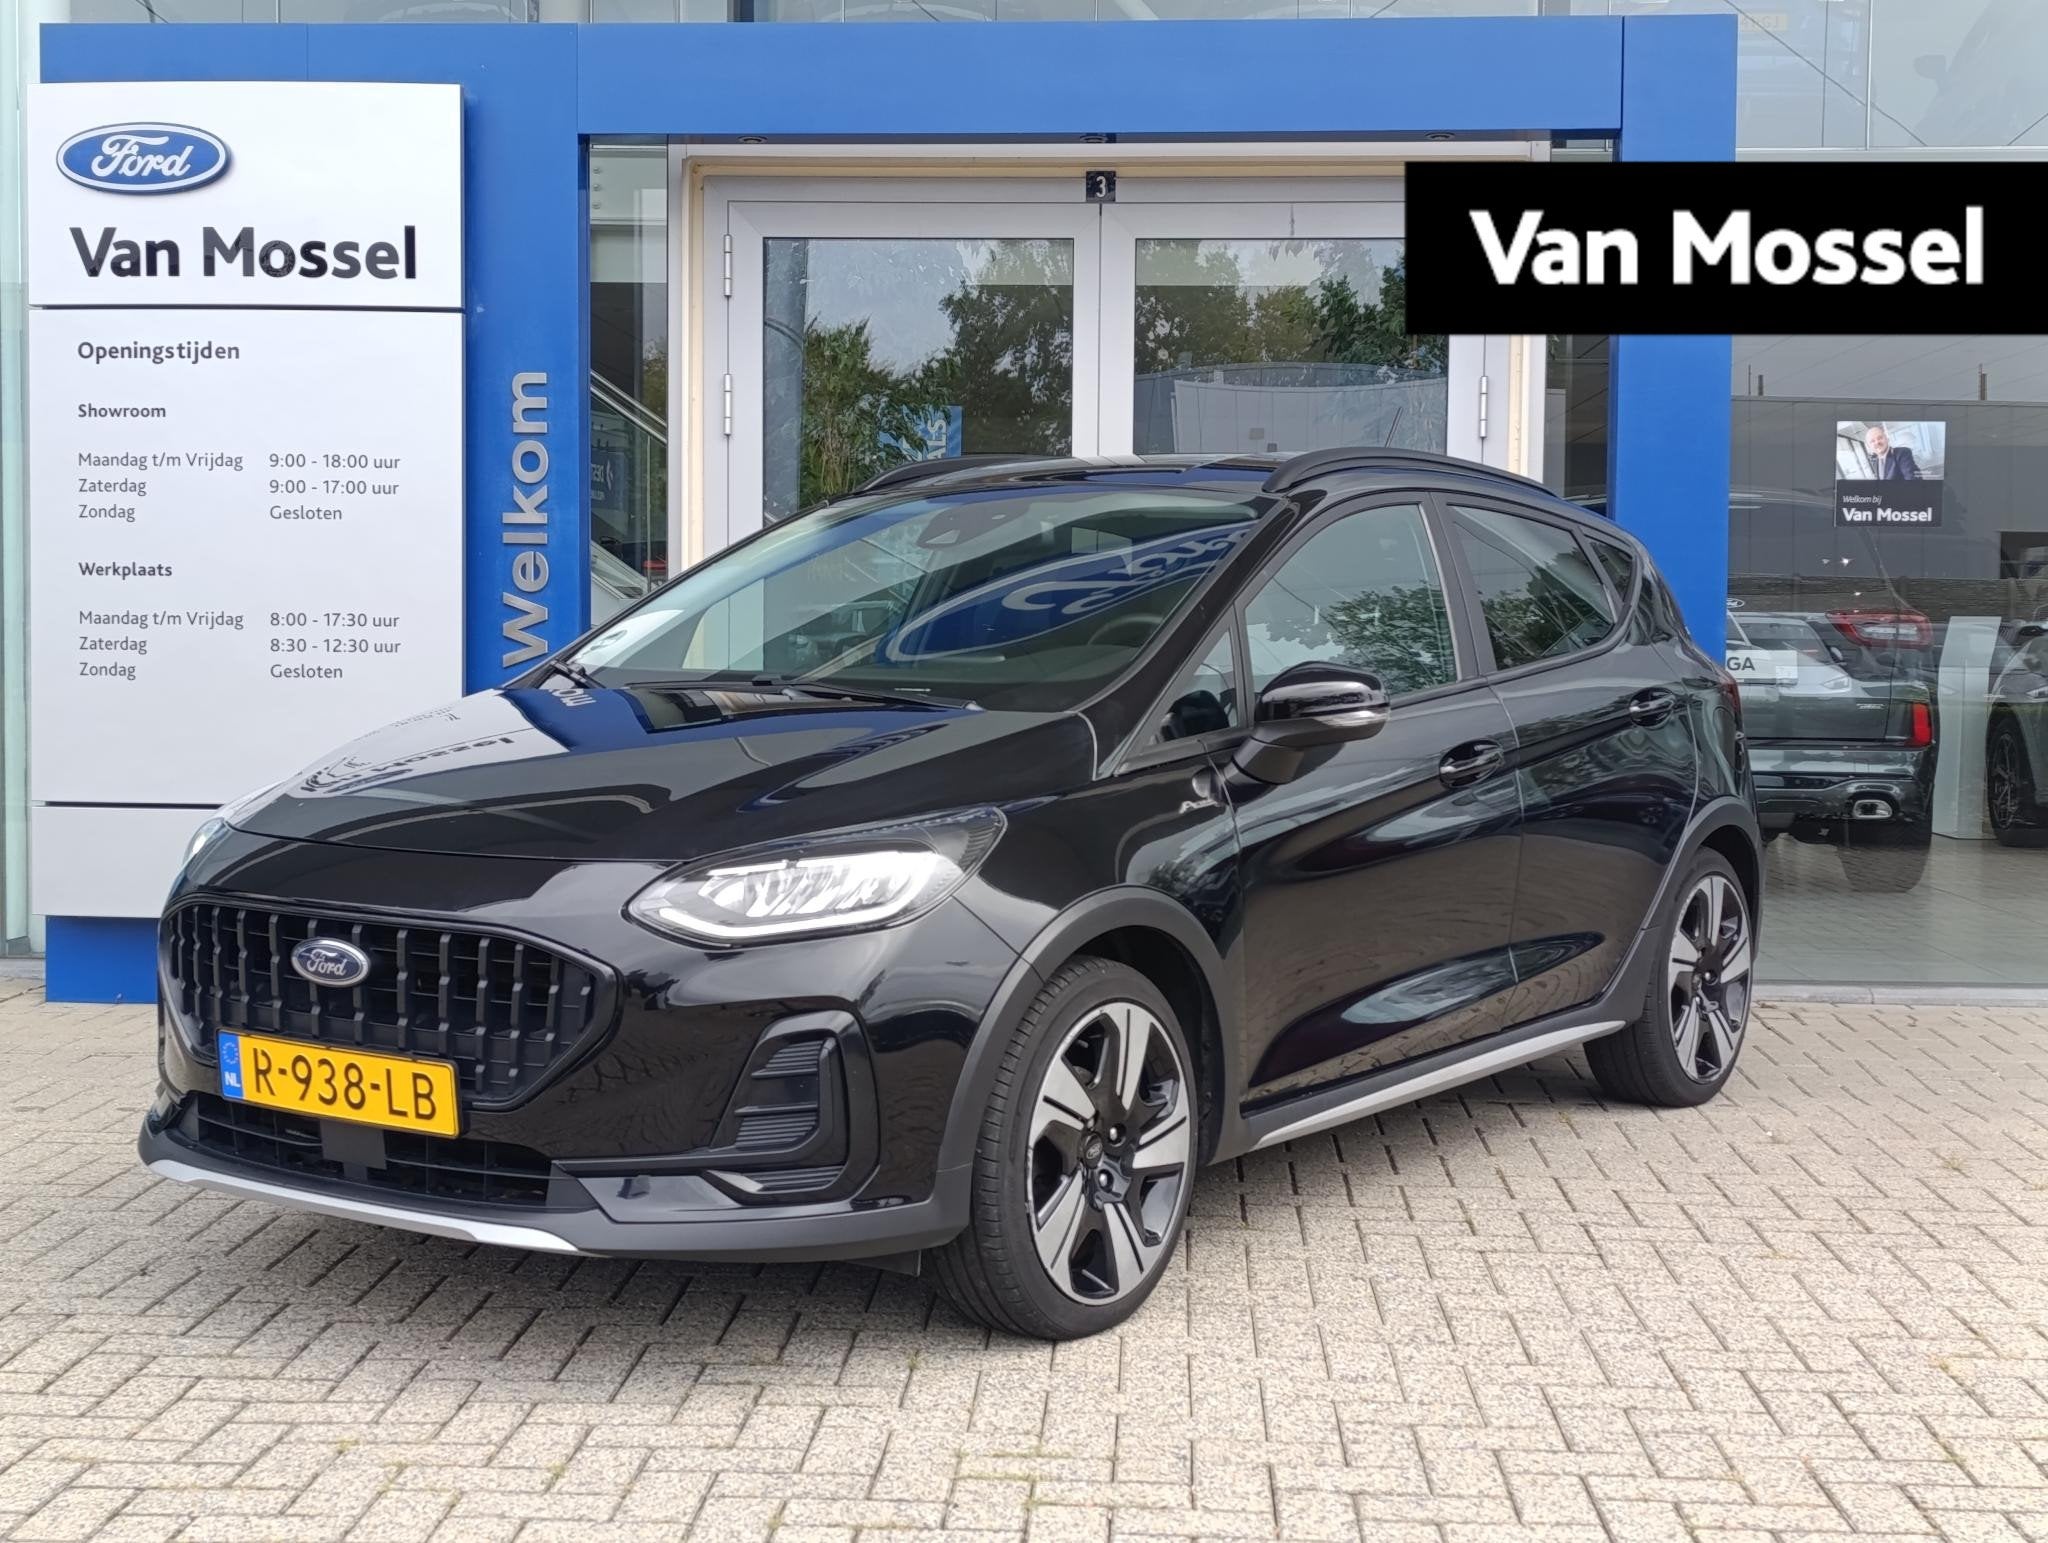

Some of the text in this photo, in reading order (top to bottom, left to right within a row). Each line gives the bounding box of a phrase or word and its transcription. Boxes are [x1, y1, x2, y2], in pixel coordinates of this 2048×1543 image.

[91, 134, 193, 178] Ford
[1095, 175, 1107, 198] 3
[69, 225, 417, 280] Van Mossel
[77, 340, 240, 365] Openingstijden
[77, 402, 167, 418] Showroom
[78, 451, 244, 472] Maandag t/m Vrijdag
[269, 453, 306, 468] 9:00
[322, 453, 369, 469] 18:00
[373, 458, 401, 469] uur
[78, 478, 147, 497] Zaterdag
[269, 479, 307, 494] 9:00
[322, 480, 367, 495] 17:00
[371, 484, 400, 495] uur
[1842, 495, 1872, 504] Welkom
[78, 503, 136, 523] Zondag
[269, 504, 343, 520] Gesloten
[502, 372, 550, 668] Welkom
[1842, 507, 1933, 522] Van Mossel
[77, 561, 173, 581] Werkplaats
[79, 610, 244, 631] Maandag t/m Vrijdag
[270, 612, 307, 627] 8:00
[323, 612, 368, 628] 17:30
[372, 616, 400, 628] uur
[79, 636, 148, 656] Zaterdag
[269, 638, 307, 653] 8:30
[323, 638, 369, 653] 12:30
[373, 642, 402, 654] uur
[79, 661, 136, 681] Zondag
[270, 663, 343, 679] Gesloten
[304, 948, 348, 976] Ford
[224, 1071, 242, 1088] NL
[253, 1047, 436, 1121] R-938-LB
